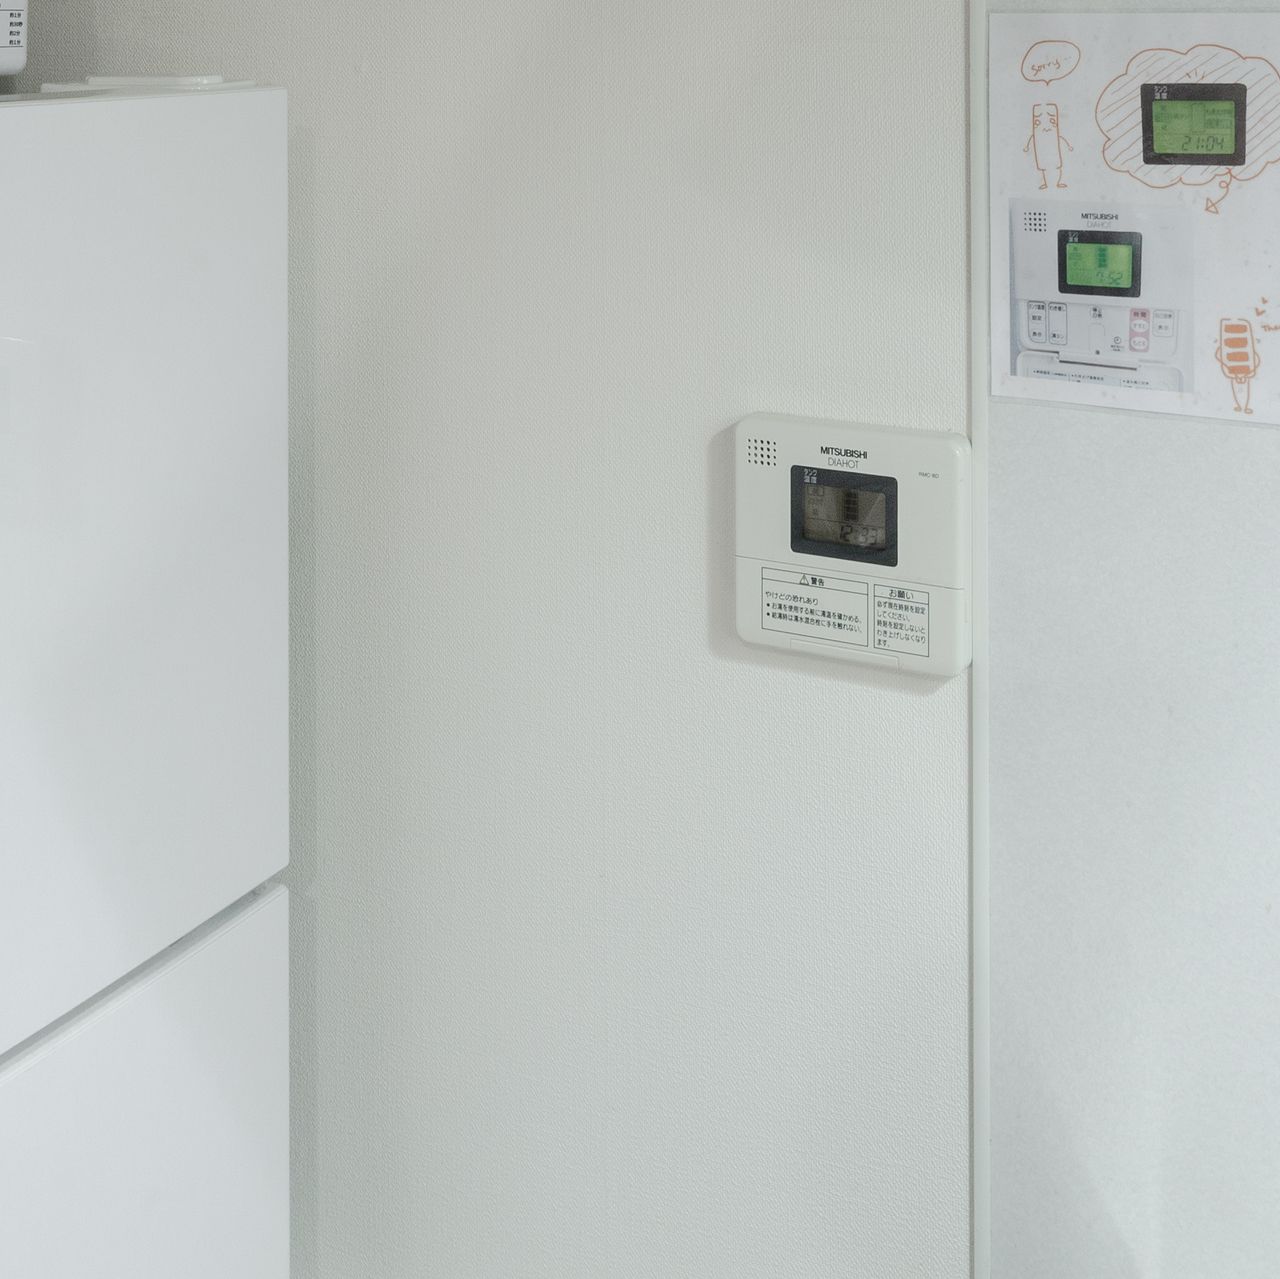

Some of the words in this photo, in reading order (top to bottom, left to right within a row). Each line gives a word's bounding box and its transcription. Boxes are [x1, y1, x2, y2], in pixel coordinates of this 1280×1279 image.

[1081, 213, 1119, 221] MITSUBISHI
[820, 445, 868, 460] MITSUBISHI
[827, 456, 860, 469] DIAHOT
[888, 589, 914, 600] お願い
